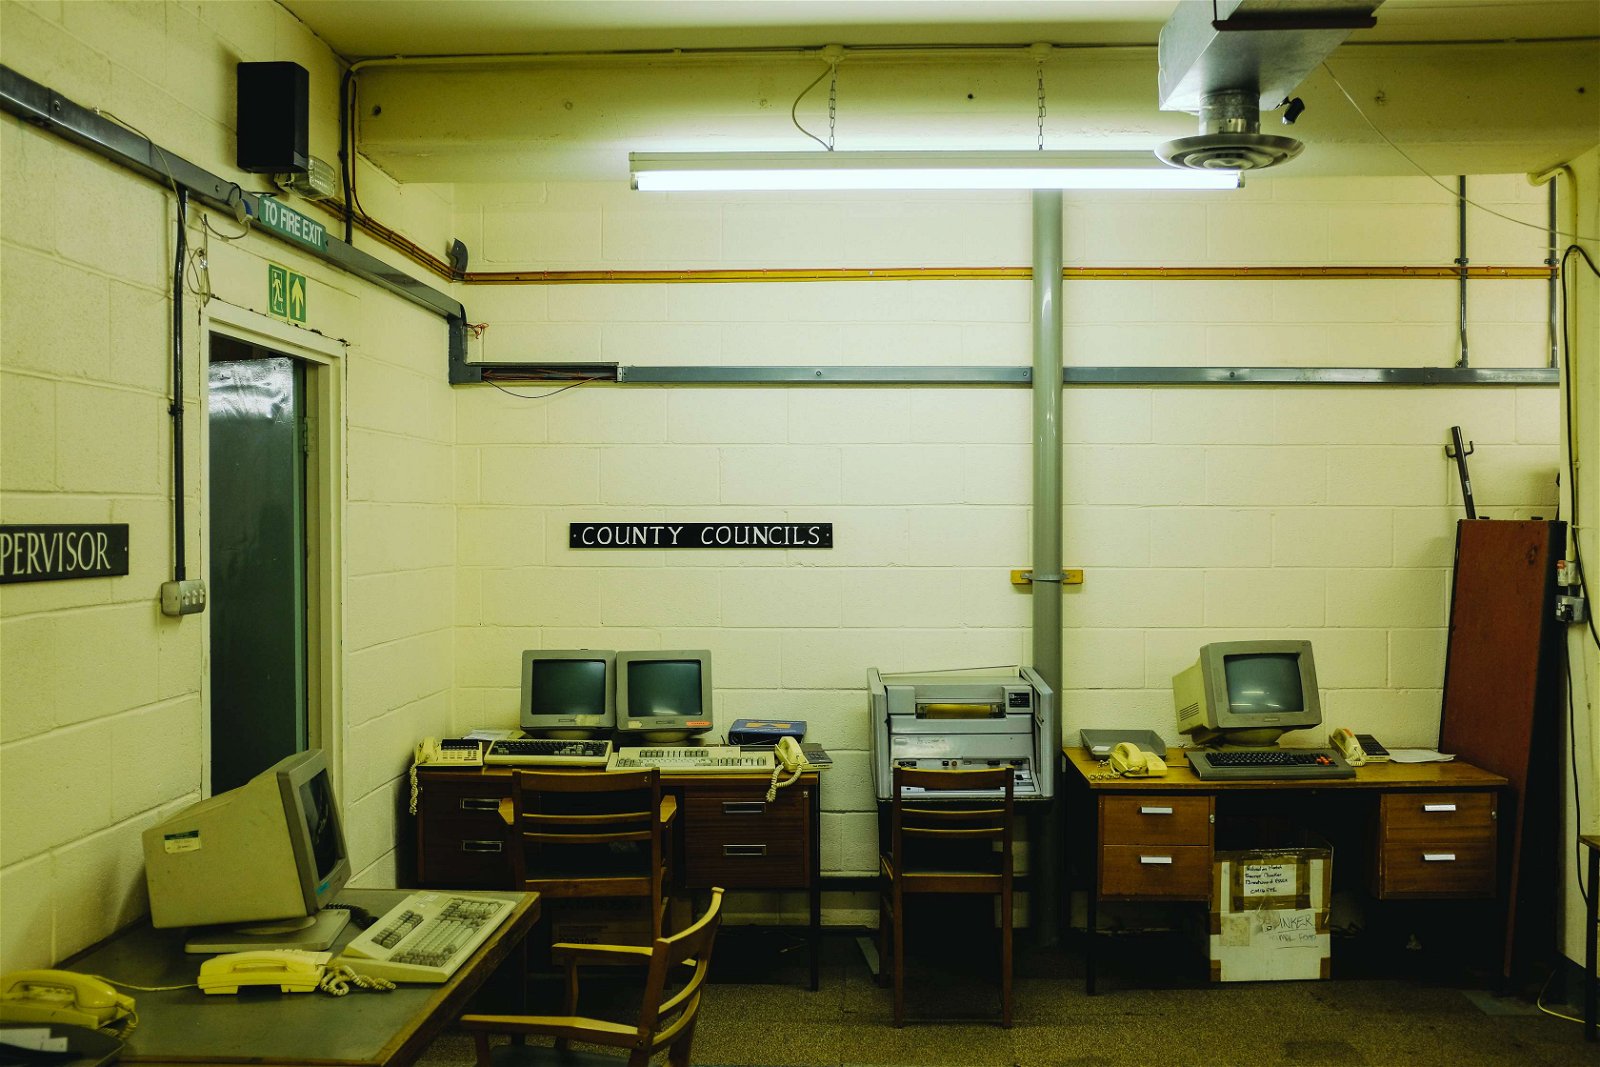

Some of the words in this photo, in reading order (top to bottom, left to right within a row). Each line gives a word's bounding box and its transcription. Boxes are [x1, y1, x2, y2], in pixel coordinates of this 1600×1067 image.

[264, 199, 278, 226] TO
[280, 208, 301, 237] FIRE
[302, 219, 323, 247] EXIT
[0, 531, 111, 576] PERVISOR
[582, 526, 684, 545] COUNTY
[701, 526, 820, 545] COUNCILS
